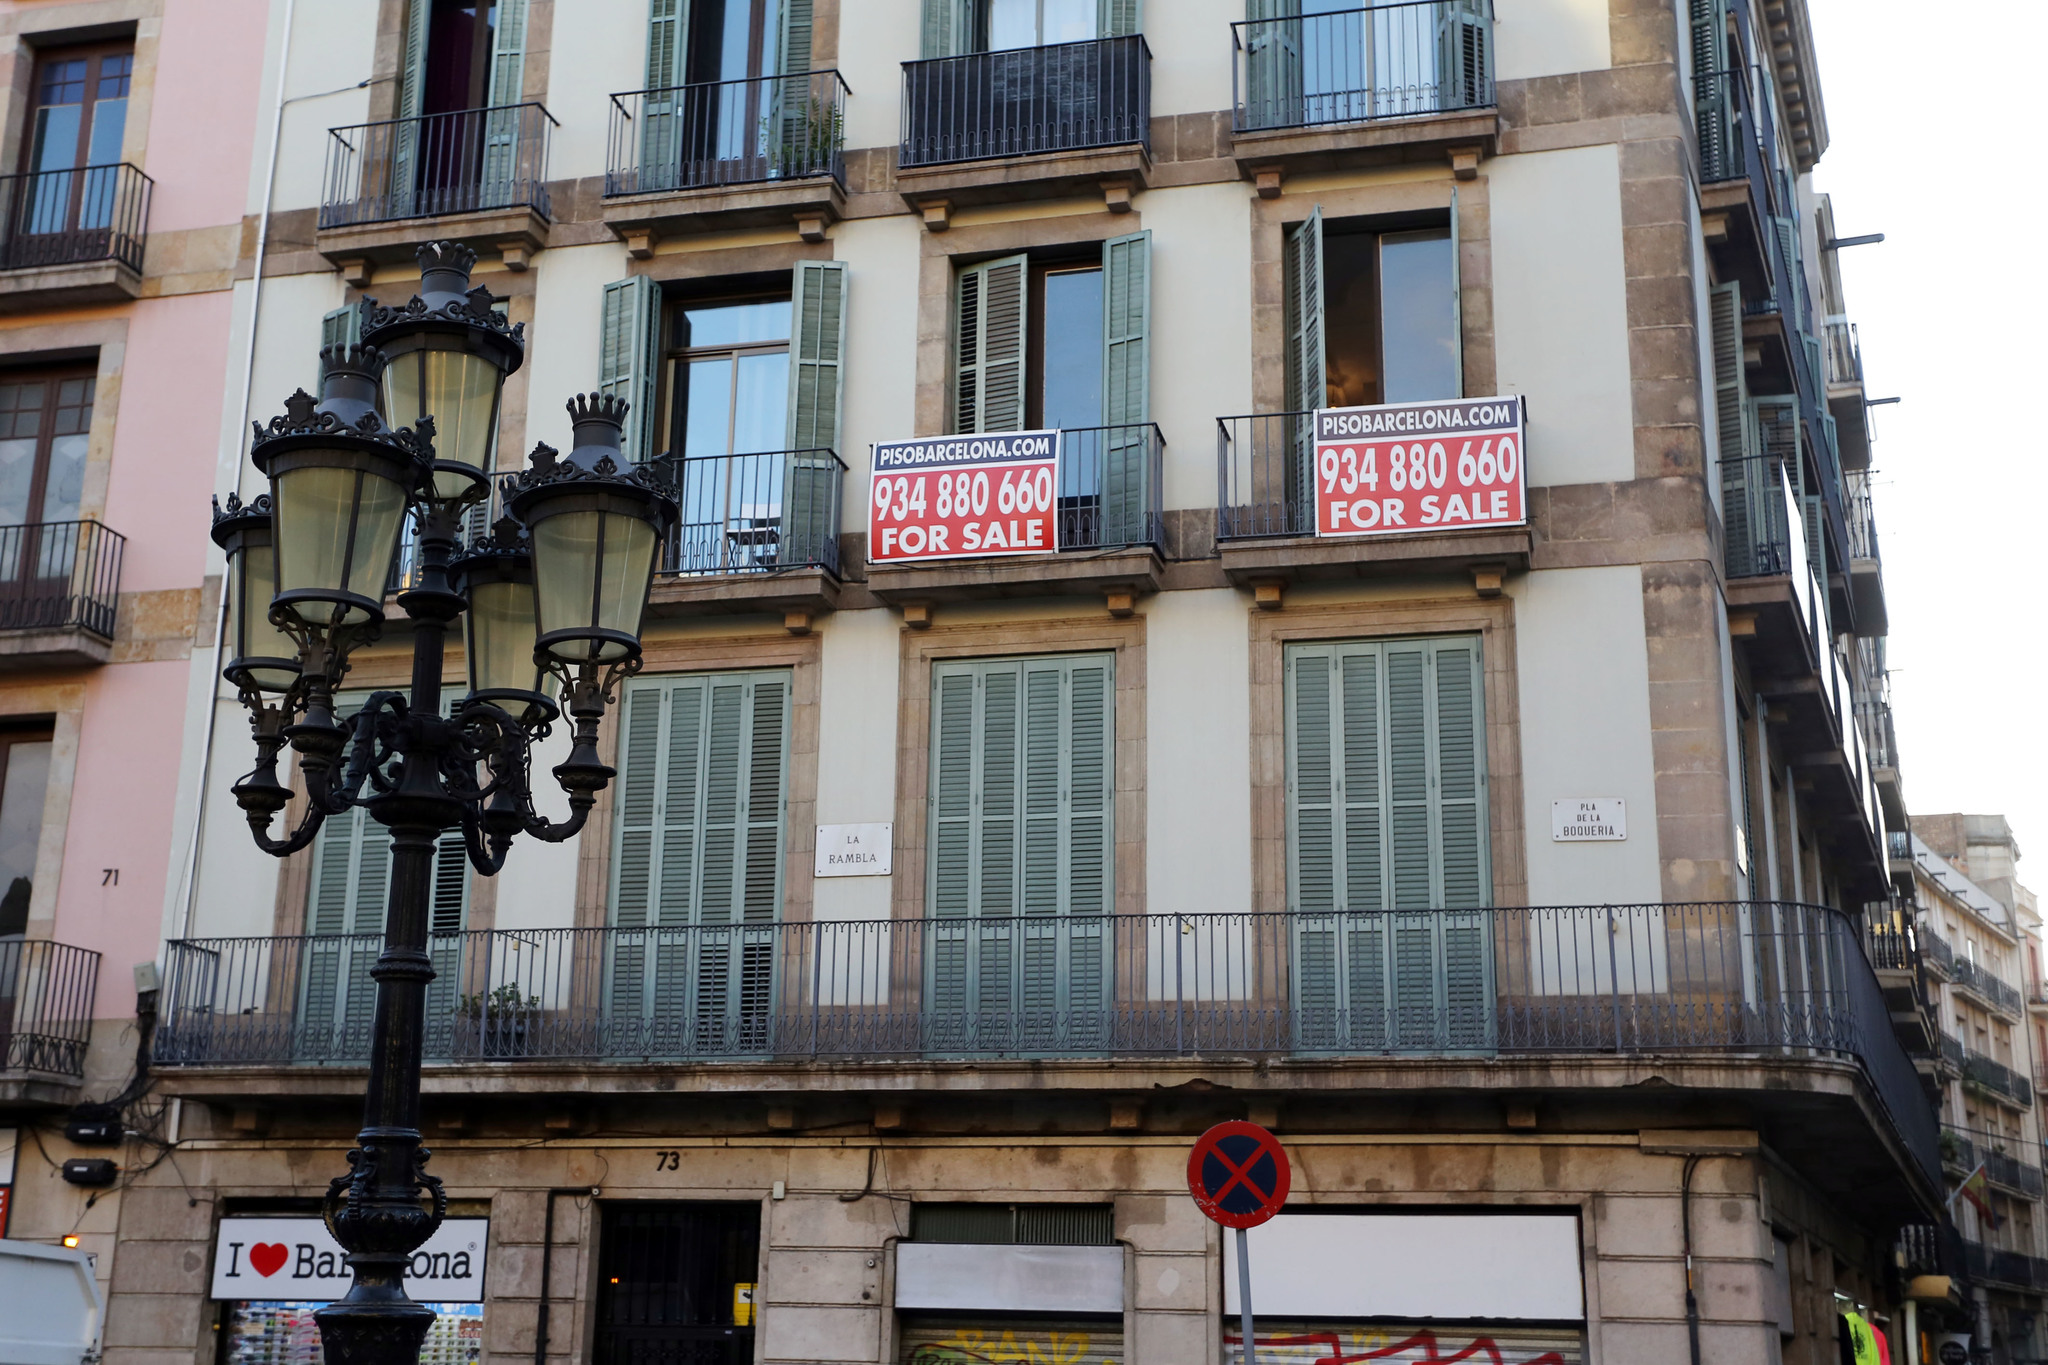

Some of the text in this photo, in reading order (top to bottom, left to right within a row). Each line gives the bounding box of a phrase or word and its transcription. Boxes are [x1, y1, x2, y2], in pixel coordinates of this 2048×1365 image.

[1322, 404, 1511, 436] PISOBARCELONA.COM
[879, 437, 1050, 466] PISOBARCELONA.COM
[1320, 436, 1517, 494] 934 880 660
[874, 466, 1053, 521] 934 880 660
[1330, 490, 1509, 529] FOR SALE
[881, 518, 1044, 556] FOR SALE
[1576, 813, 1601, 822] DE LA
[1580, 803, 1597, 811] PLA
[847, 835, 860, 844] LA
[1563, 825, 1615, 837] BOQUERIA
[828, 853, 877, 864] RAMBLA
[102, 869, 119, 886] 71
[656, 1151, 680, 1171] 73
[225, 1242, 472, 1279] I Barona
